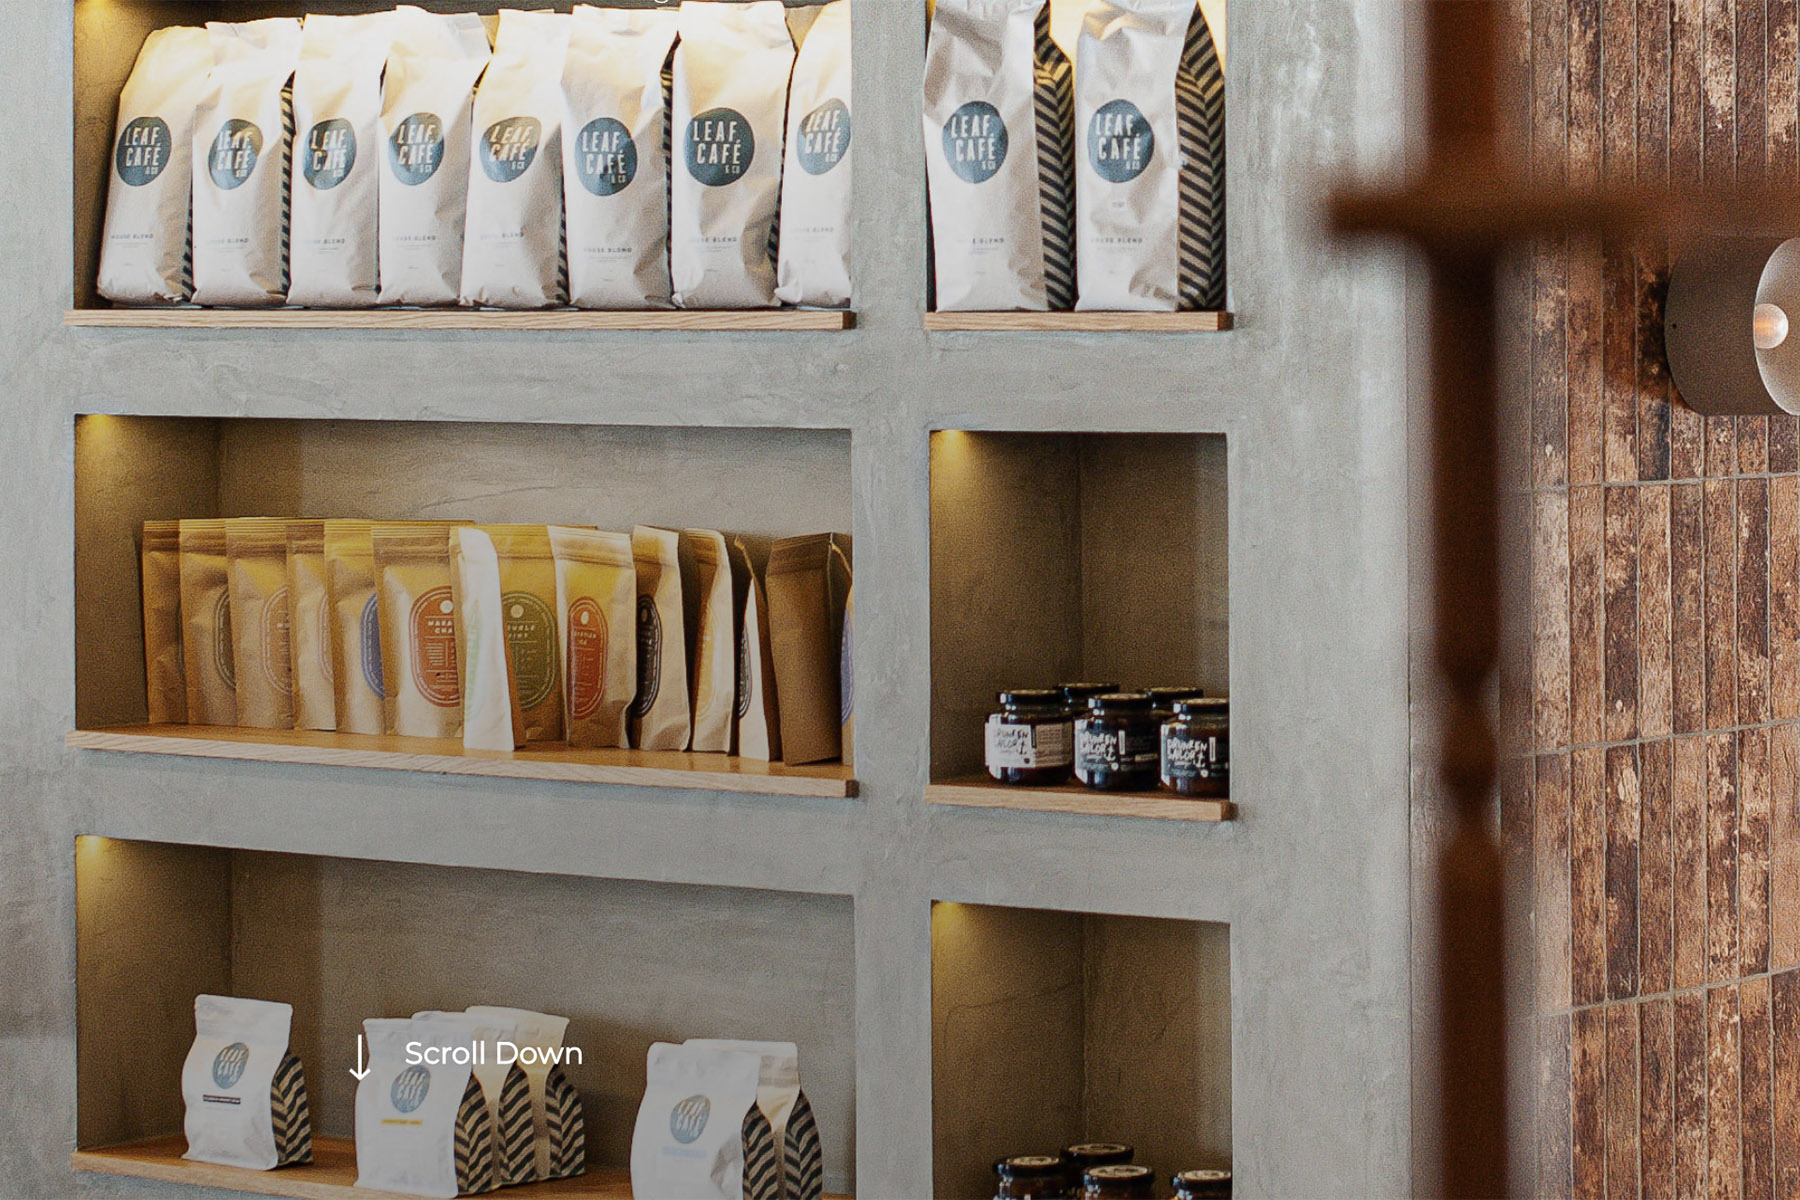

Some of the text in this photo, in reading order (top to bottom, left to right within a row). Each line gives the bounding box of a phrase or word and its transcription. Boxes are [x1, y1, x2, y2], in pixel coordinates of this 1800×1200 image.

[805, 110, 841, 132] LEAF
[952, 114, 991, 138] LEAF
[1096, 113, 1133, 136] LEAF
[125, 127, 160, 146] LEAF
[219, 130, 253, 150] LEAF
[311, 130, 346, 149] LEAF
[397, 125, 436, 144] LEAF
[490, 126, 532, 144] LEAF
[693, 121, 738, 142] LEAF
[582, 132, 621, 153] LEAF
